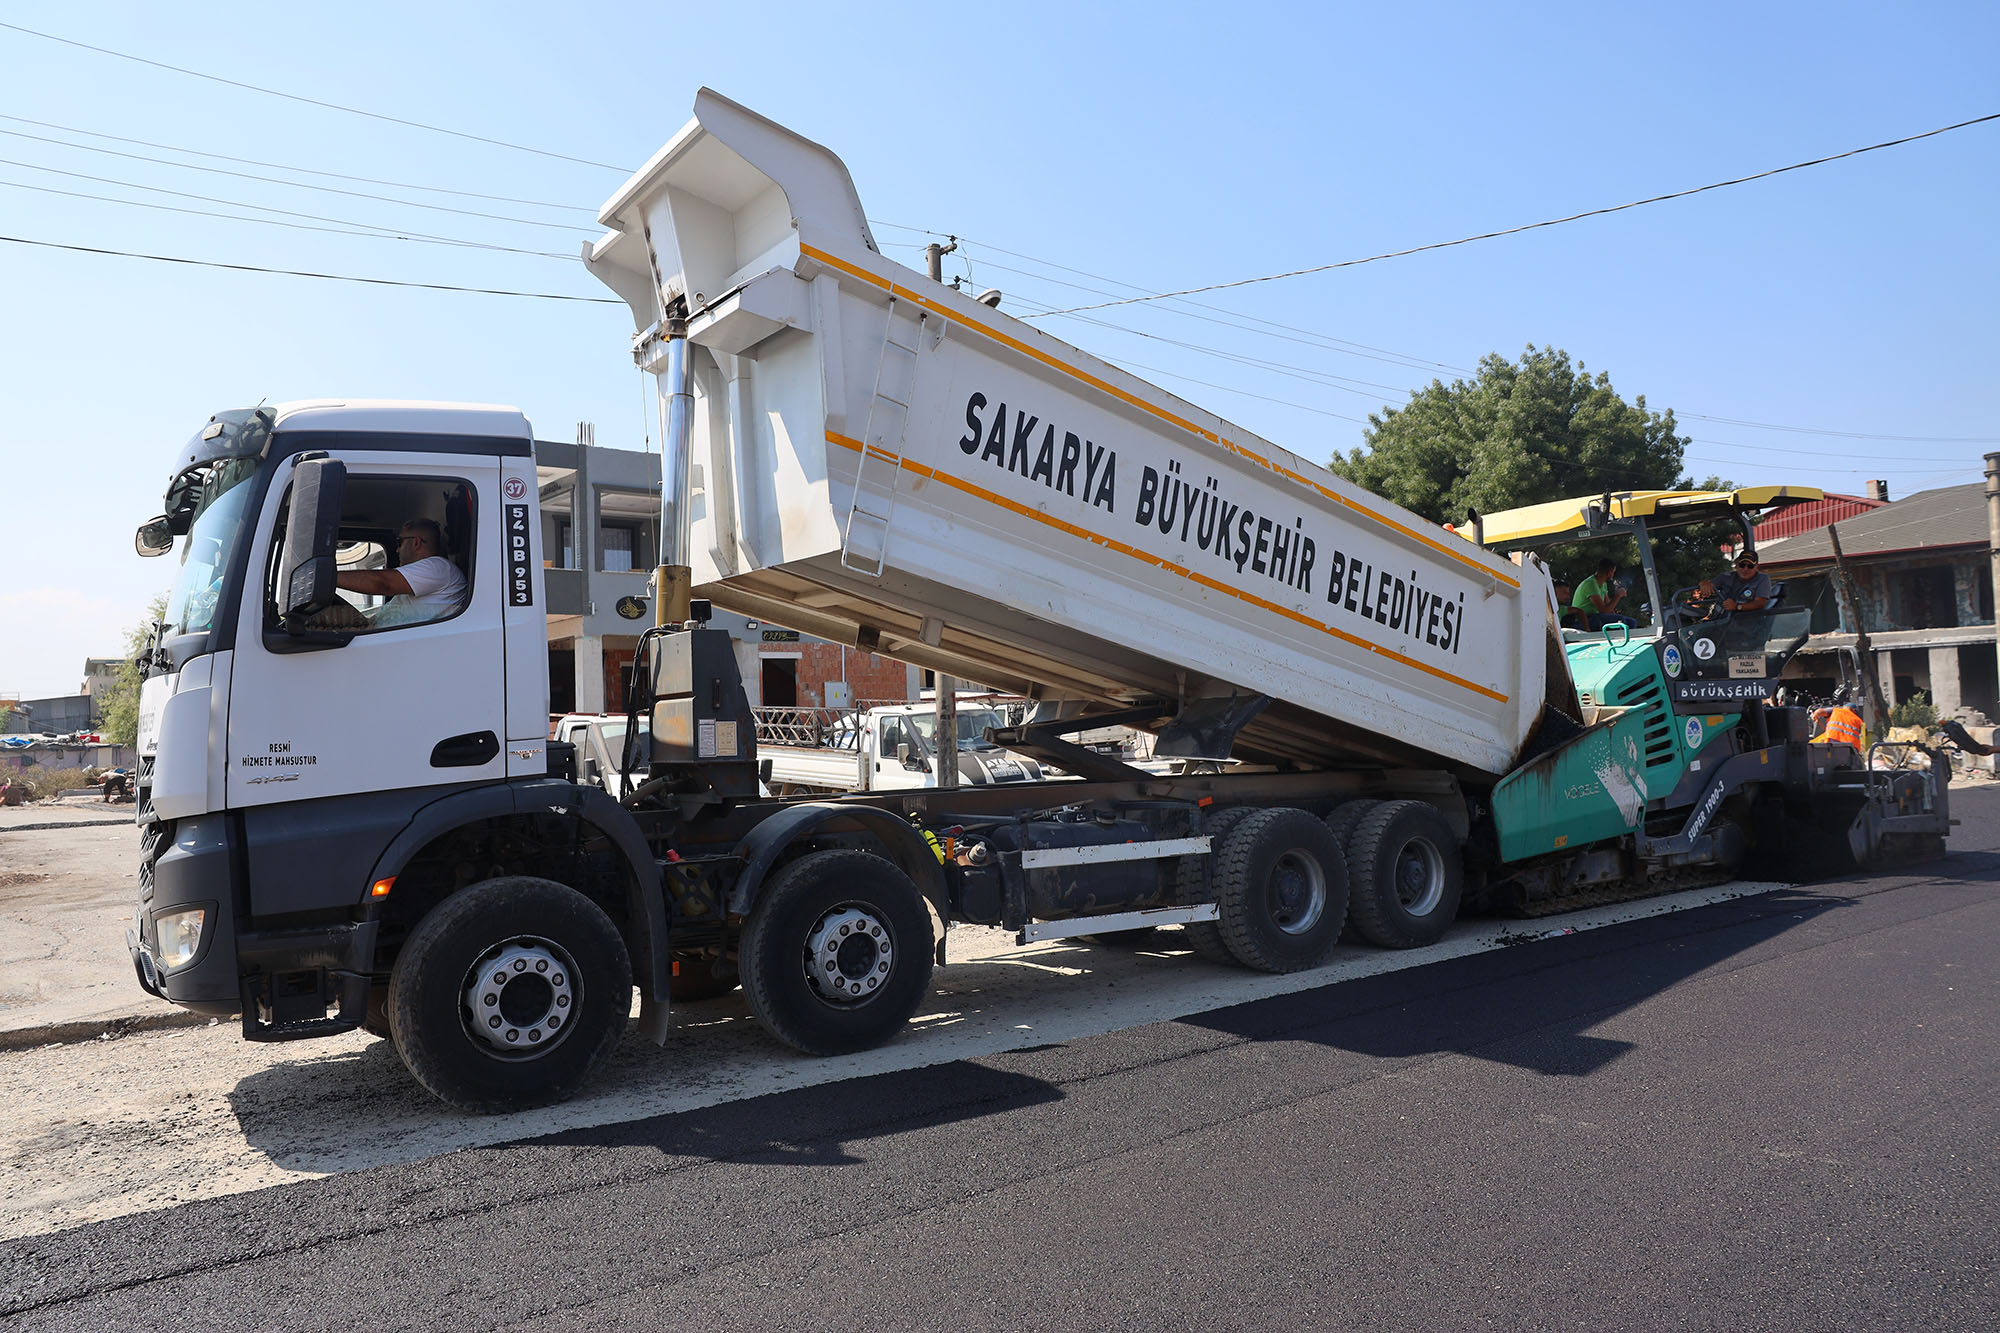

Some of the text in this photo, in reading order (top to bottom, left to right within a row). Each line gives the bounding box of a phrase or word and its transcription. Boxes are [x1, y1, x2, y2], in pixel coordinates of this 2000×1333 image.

[507, 482, 523, 495] 37
[959, 391, 1465, 654] SAKARYA BÜYÜKŞEHİR BELEDİYESİ
[512, 507, 528, 603] 54 DB 953
[1699, 640, 1711, 657] 2
[1681, 682, 1767, 698] BÜYÜKŞEHİR
[269, 740, 291, 753] RESMİ
[242, 754, 317, 767] HİZMETE MAHSUSTUR
[1688, 780, 1725, 843] SUPER 1900-3
